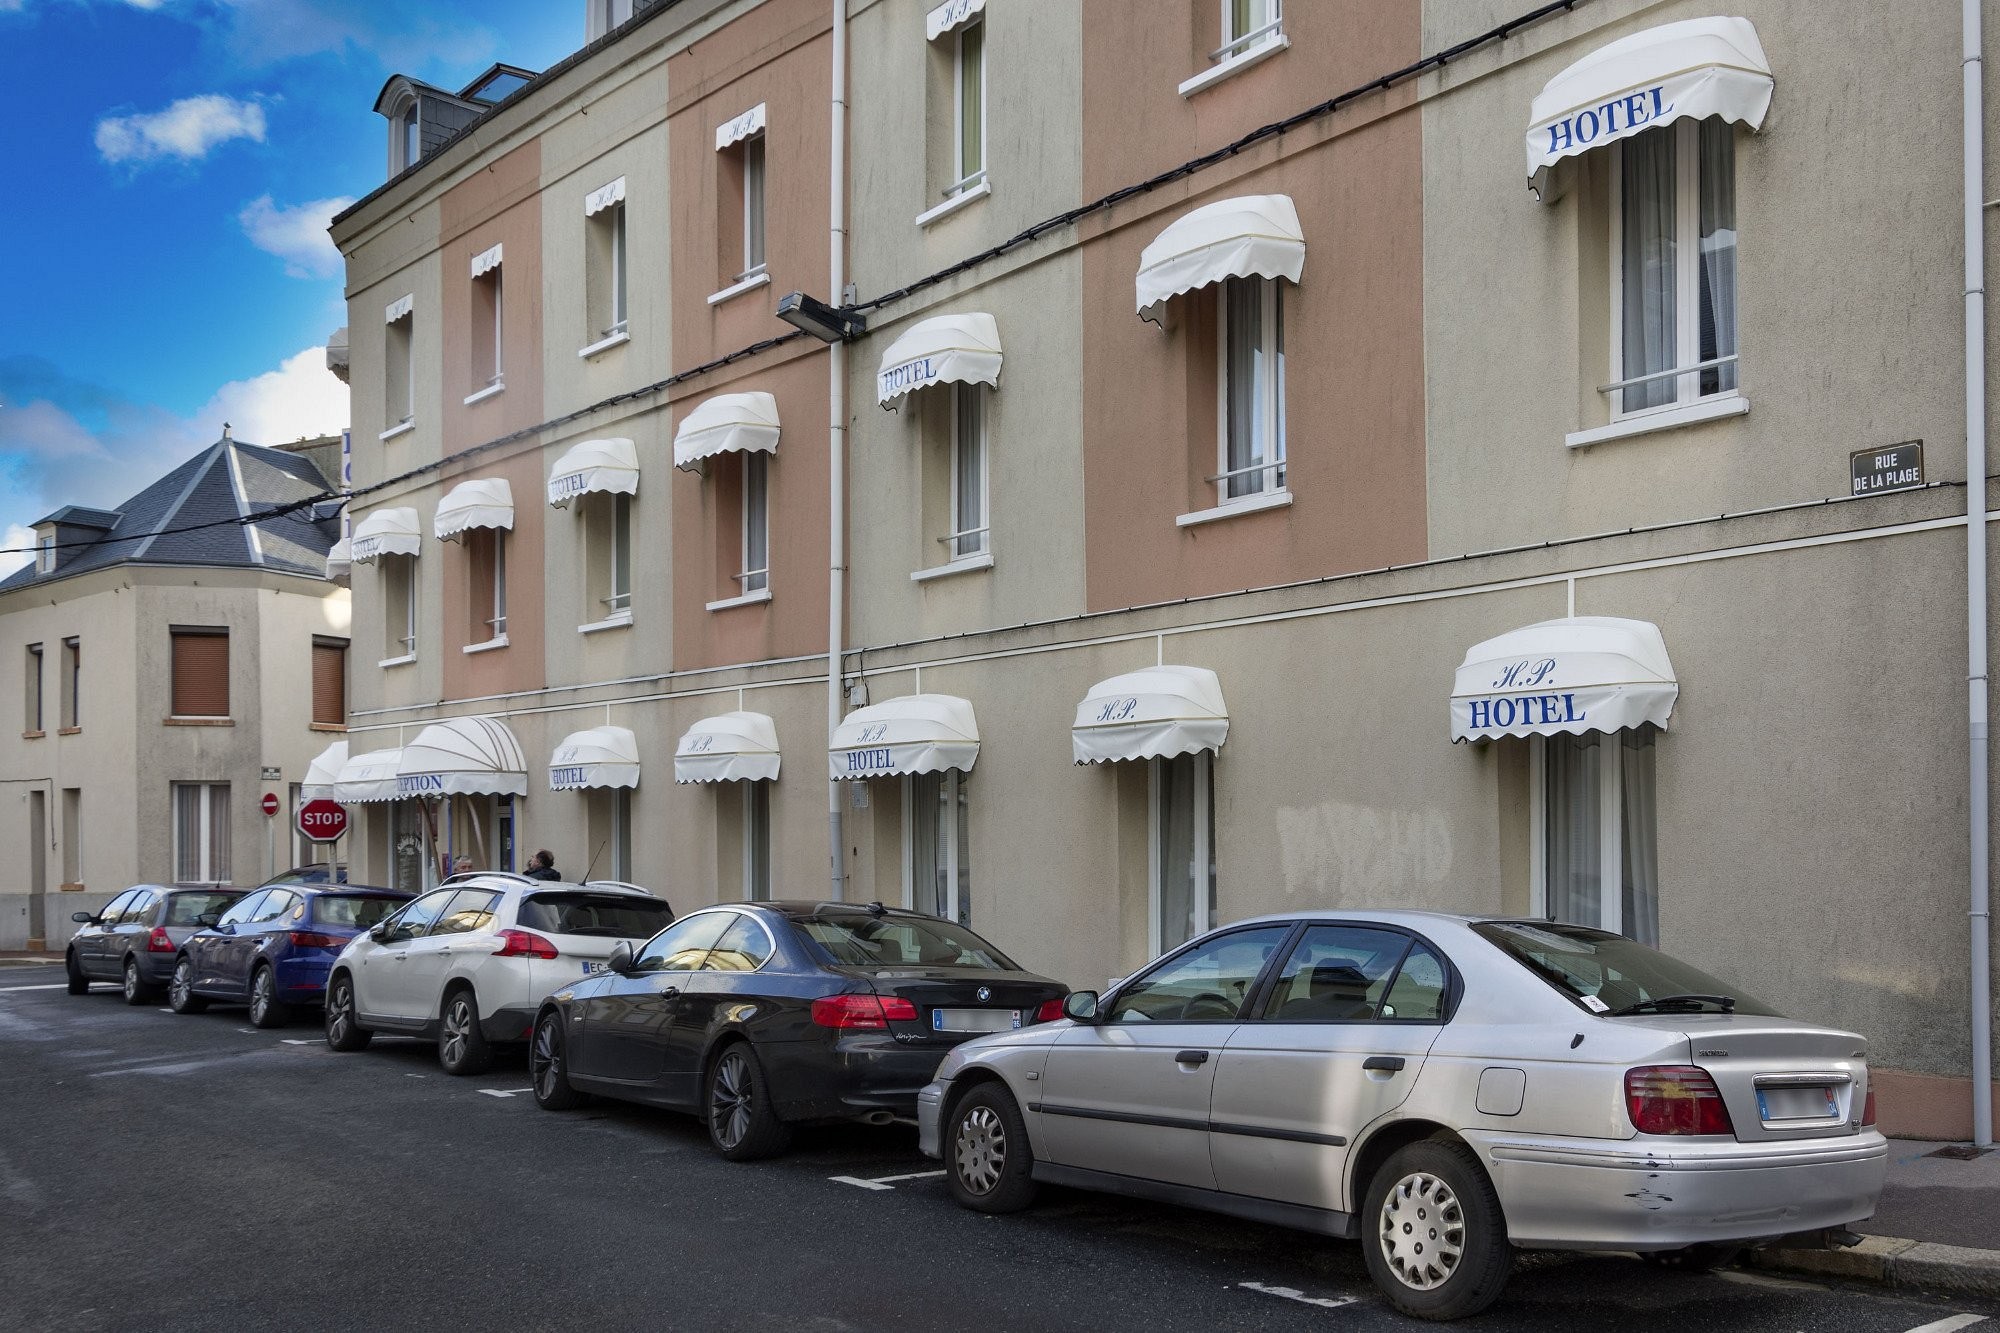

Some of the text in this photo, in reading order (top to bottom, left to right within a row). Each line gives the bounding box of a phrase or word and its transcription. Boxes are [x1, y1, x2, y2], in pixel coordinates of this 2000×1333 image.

[1546, 86, 1675, 155] HOTEL
[883, 357, 937, 393] HOTEL
[1875, 453, 1898, 470] RUE
[551, 473, 588, 496] HOTEL
[1854, 467, 1919, 491] DE LA PLAGE
[1468, 693, 1586, 729] HOTEL
[846, 748, 895, 771] HOTEL
[552, 767, 588, 785] HOTEL
[304, 812, 344, 825] STOP
